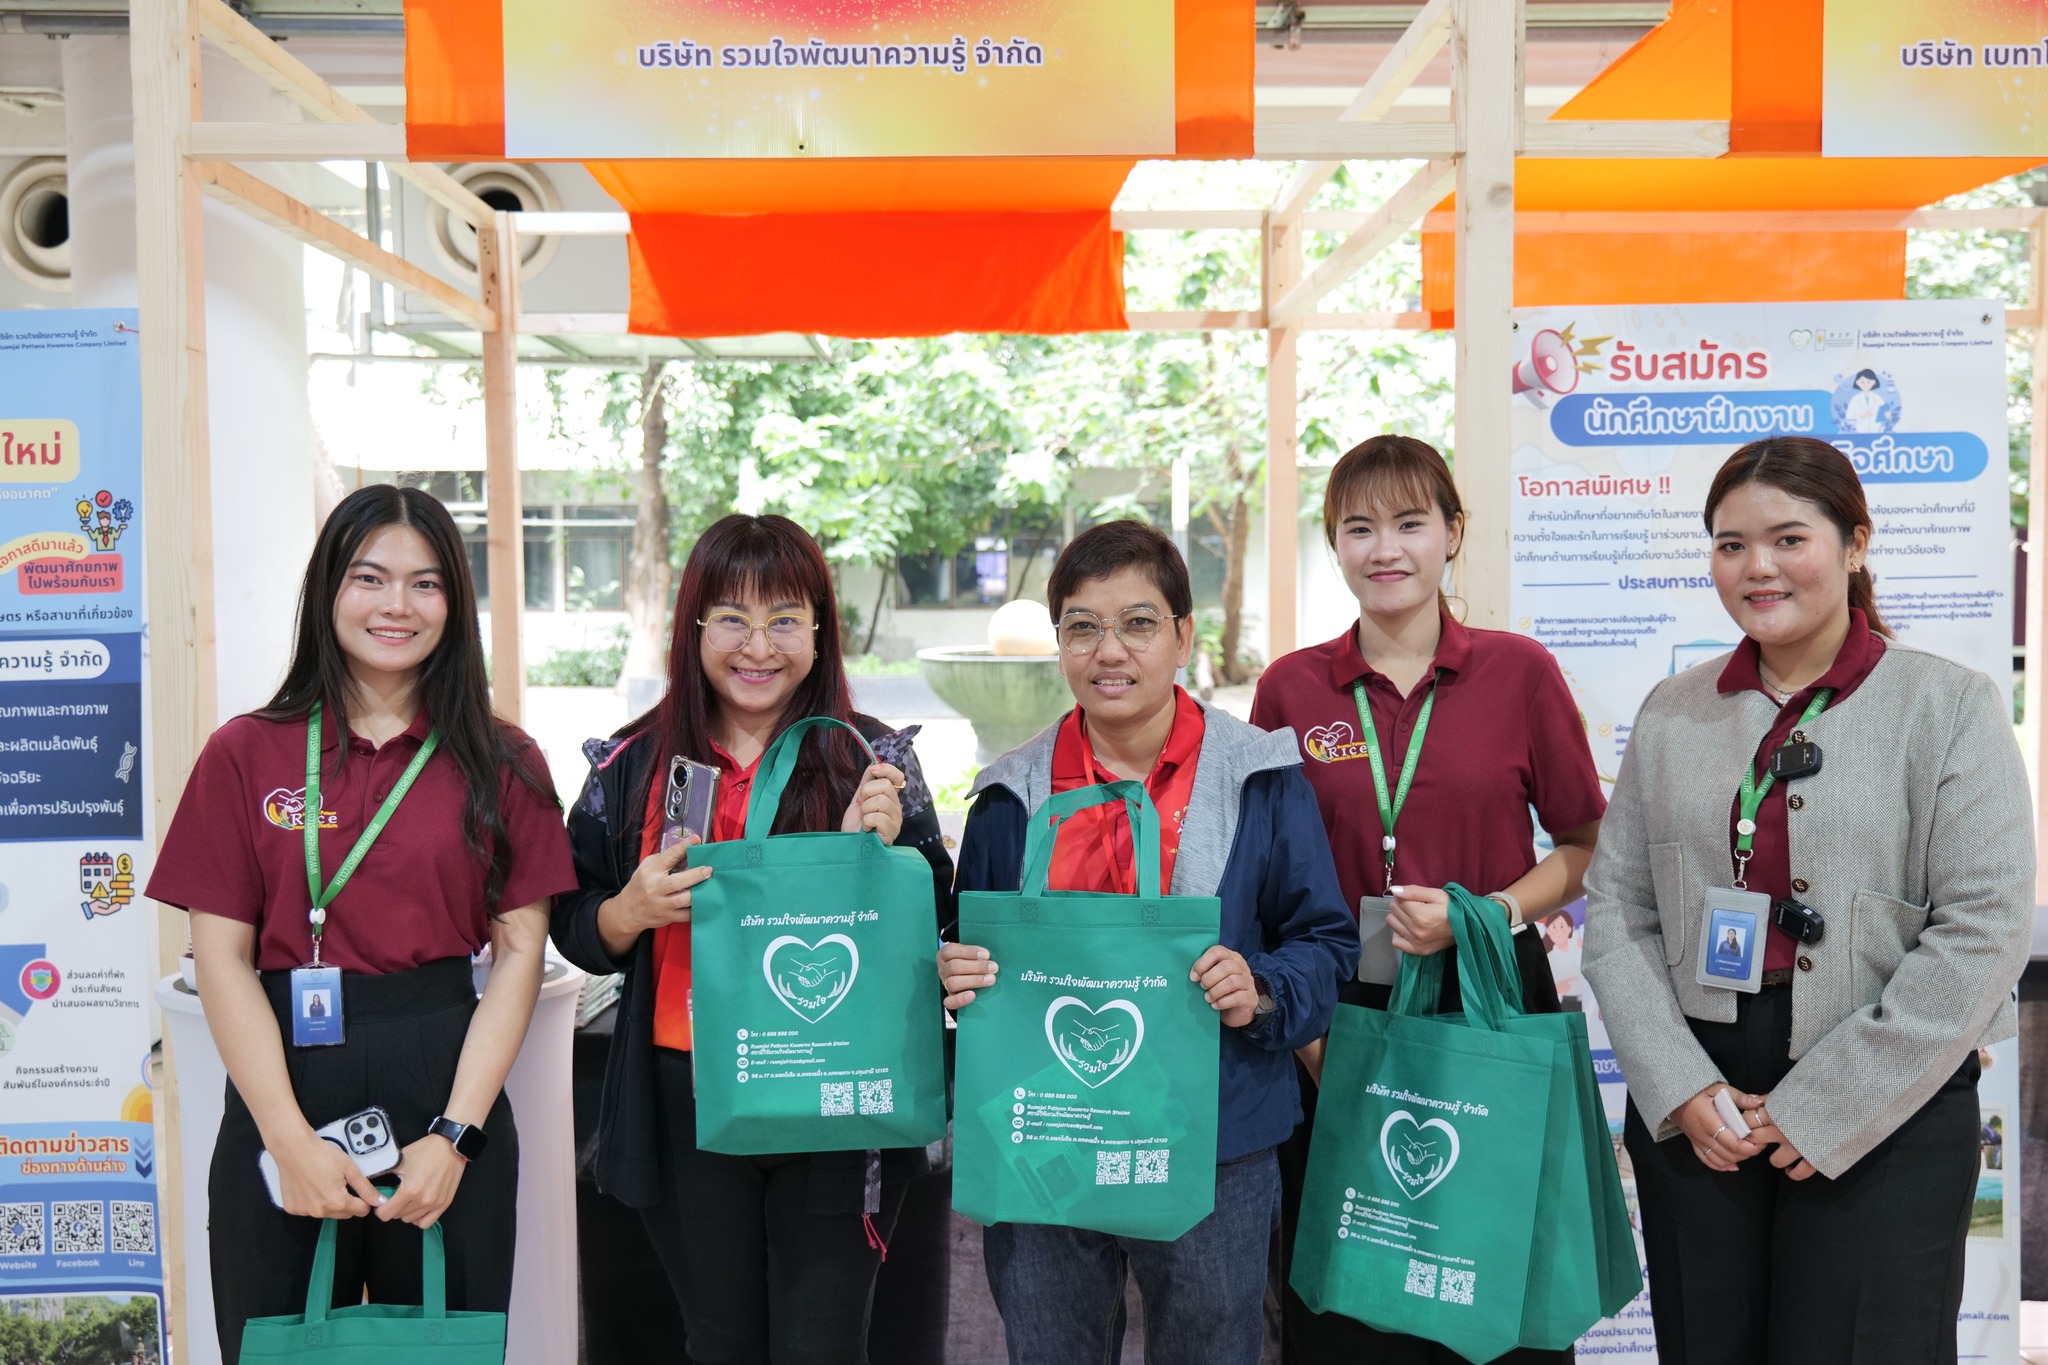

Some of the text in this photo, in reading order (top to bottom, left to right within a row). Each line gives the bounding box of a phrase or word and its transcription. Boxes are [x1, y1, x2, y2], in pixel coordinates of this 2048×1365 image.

[638, 38, 1042, 72] บริษัท รวมใจพัฒนาความรู้ จำกัด
[1901, 40, 1973, 67] บริษัท
[1609, 339, 1769, 382] รับสมัคร
[1584, 396, 1814, 436] นักศึกษาฝึกงาน
[2, 431, 62, 466] ใหม่
[1838, 435, 1954, 475] ิจศึกษา
[1518, 475, 1671, 498] โอกาสพิเศษ !!
[24, 560, 118, 575] พัฒนาศักยภาพ
[27, 574, 115, 590] ไปพร้อมกับเรา
[26, 604, 133, 621] หรือสาขาที่เกี่ยวข้อง
[60, 650, 103, 668] จำกัด
[290, 813, 338, 826] Rce
[335, 823, 381, 887] WWW.PINEHURST.CO.TH
[740, 910, 879, 927] บริษัท รวมใจพัฒนาความรู้ จำกัด
[1020, 970, 1168, 993] บริษัท รวมใจพัฒนาความรู้ จำกัด
[1462, 1102, 1489, 1117] จำกัด
[21, 1158, 126, 1175] ช่องทางด้านล่าง
[0, 1258, 146, 1270] Website Facebook Line
